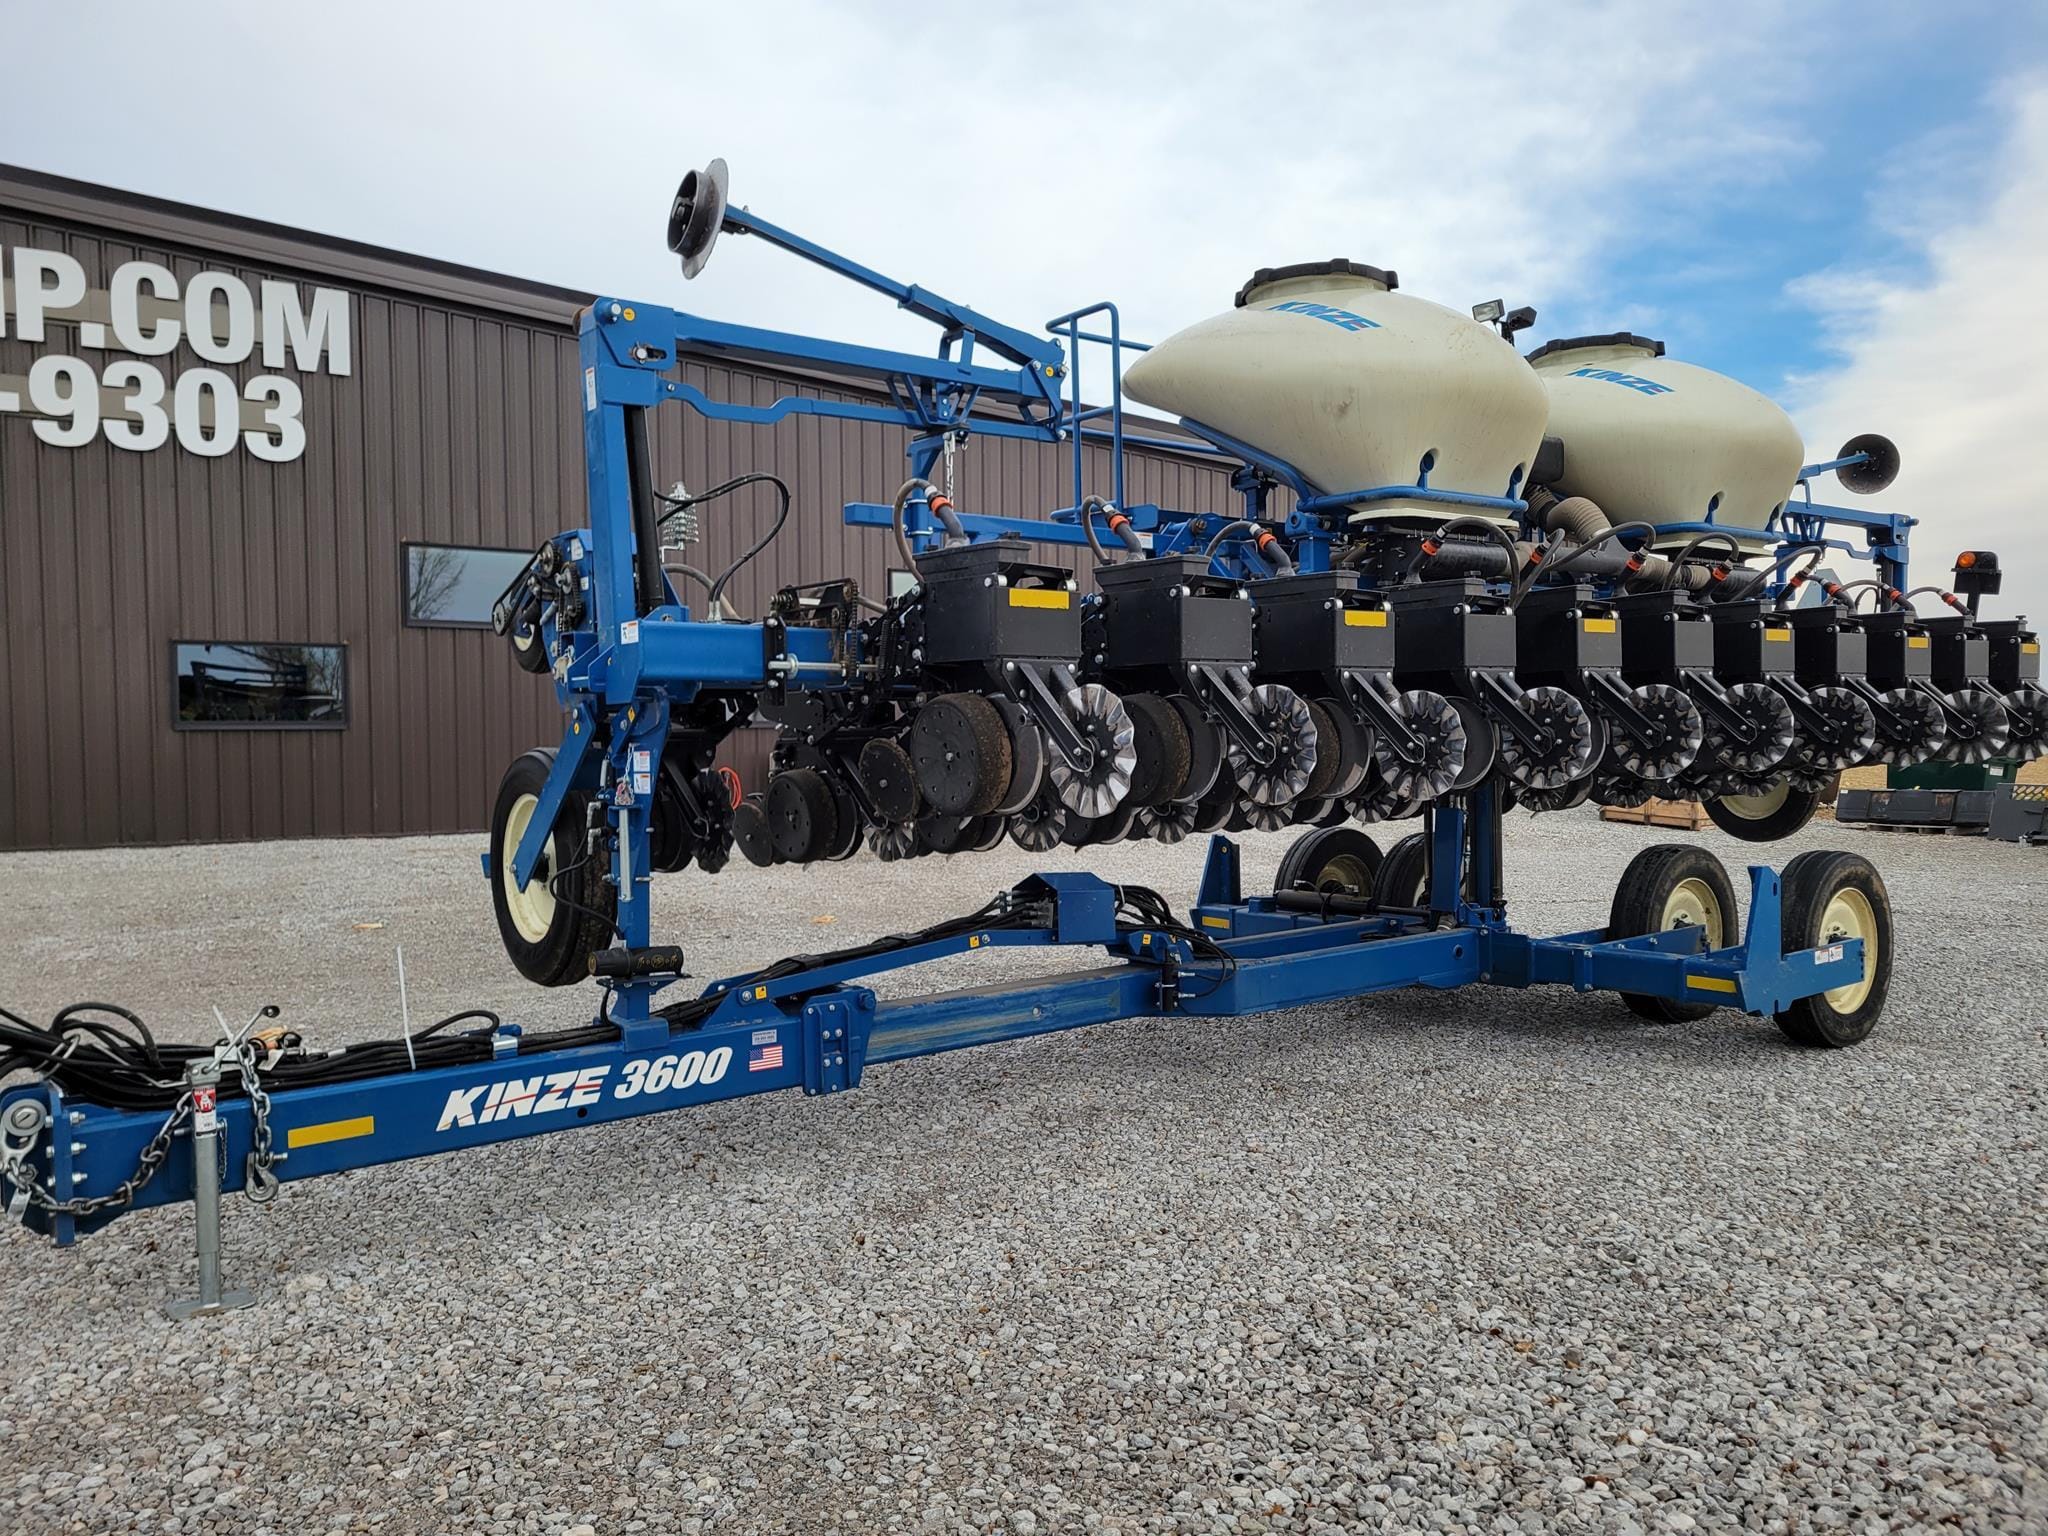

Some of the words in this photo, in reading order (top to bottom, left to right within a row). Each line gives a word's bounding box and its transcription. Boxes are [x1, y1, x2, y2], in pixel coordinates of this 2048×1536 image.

[0, 244, 350, 376] P.COM
[1265, 301, 1382, 332] KINZE
[0, 354, 306, 462] -9303
[1564, 368, 1675, 396] KINZE
[435, 1065, 612, 1132] KINZE
[613, 1046, 734, 1099] 3600
